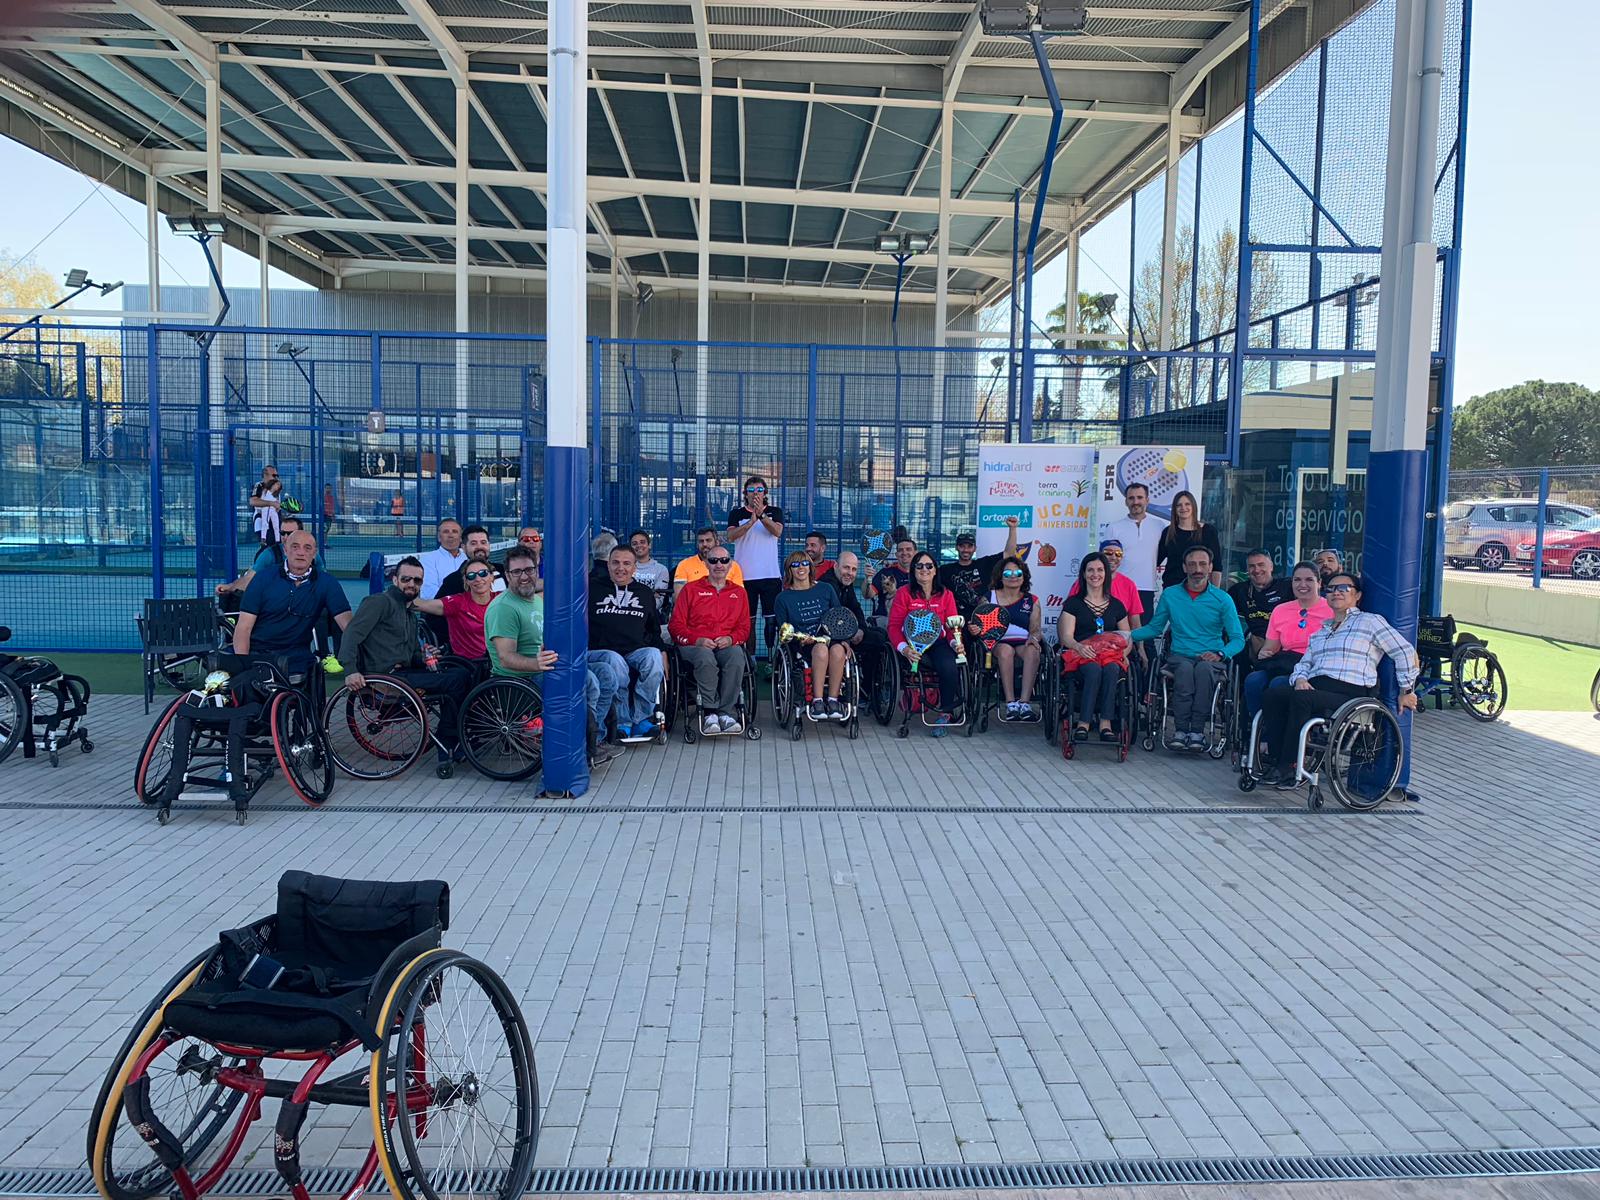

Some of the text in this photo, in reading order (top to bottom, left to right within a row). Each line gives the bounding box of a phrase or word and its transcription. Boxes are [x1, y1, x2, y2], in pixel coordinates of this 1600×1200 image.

[983, 462, 1032, 472] hidralard
[1104, 464, 1115, 501] PSR
[1038, 490, 1072, 498] training
[1037, 503, 1089, 519] UCAM
[1275, 500, 1363, 533] de servicio
[1037, 520, 1088, 529] UNIVERSIDAD
[1274, 545, 1282, 566] a
[596, 605, 644, 618] akkeron
